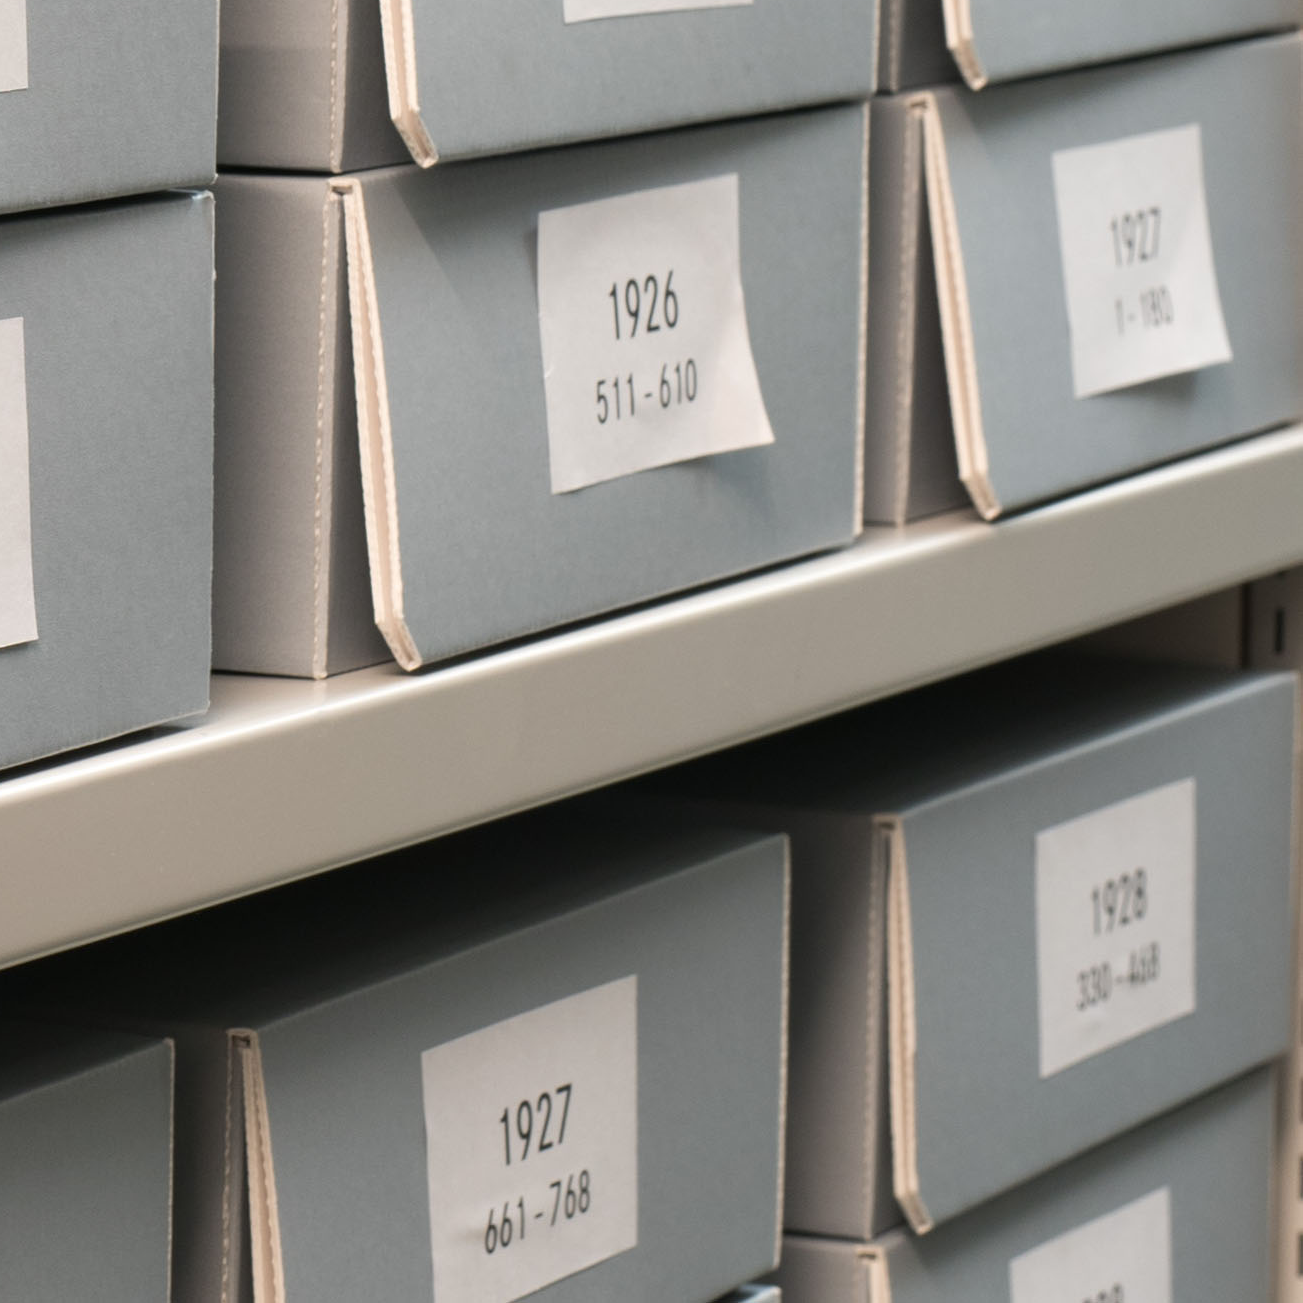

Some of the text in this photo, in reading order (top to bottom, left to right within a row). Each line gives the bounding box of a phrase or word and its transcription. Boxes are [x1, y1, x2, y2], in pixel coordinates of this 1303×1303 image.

[1110, 205, 1162, 267] 1927
[610, 270, 679, 340] 1926
[1090, 867, 1147, 935] 1928
[500, 1084, 572, 1165] 1927
[483, 1169, 592, 1255] 661-768
